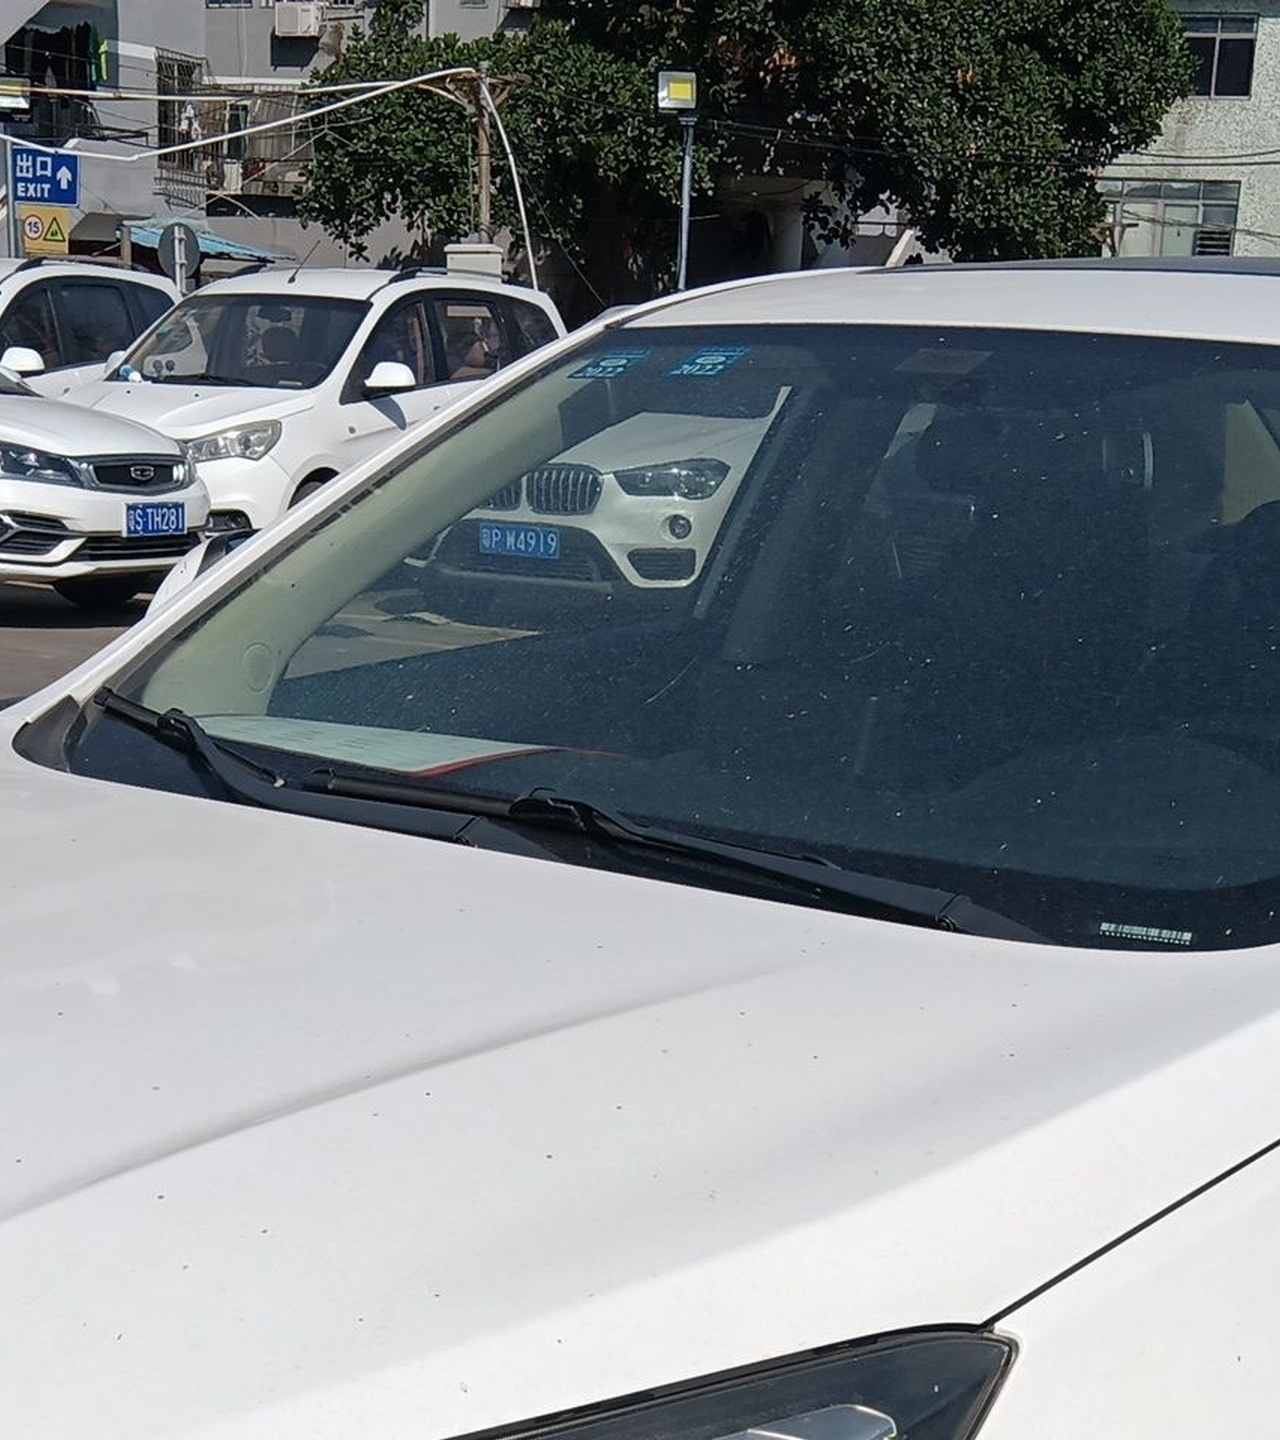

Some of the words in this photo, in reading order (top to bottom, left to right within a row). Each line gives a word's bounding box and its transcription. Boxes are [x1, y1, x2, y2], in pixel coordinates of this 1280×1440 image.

[16, 154, 52, 178] 出口
[17, 182, 51, 198] EXIT
[27, 221, 40, 234] 15
